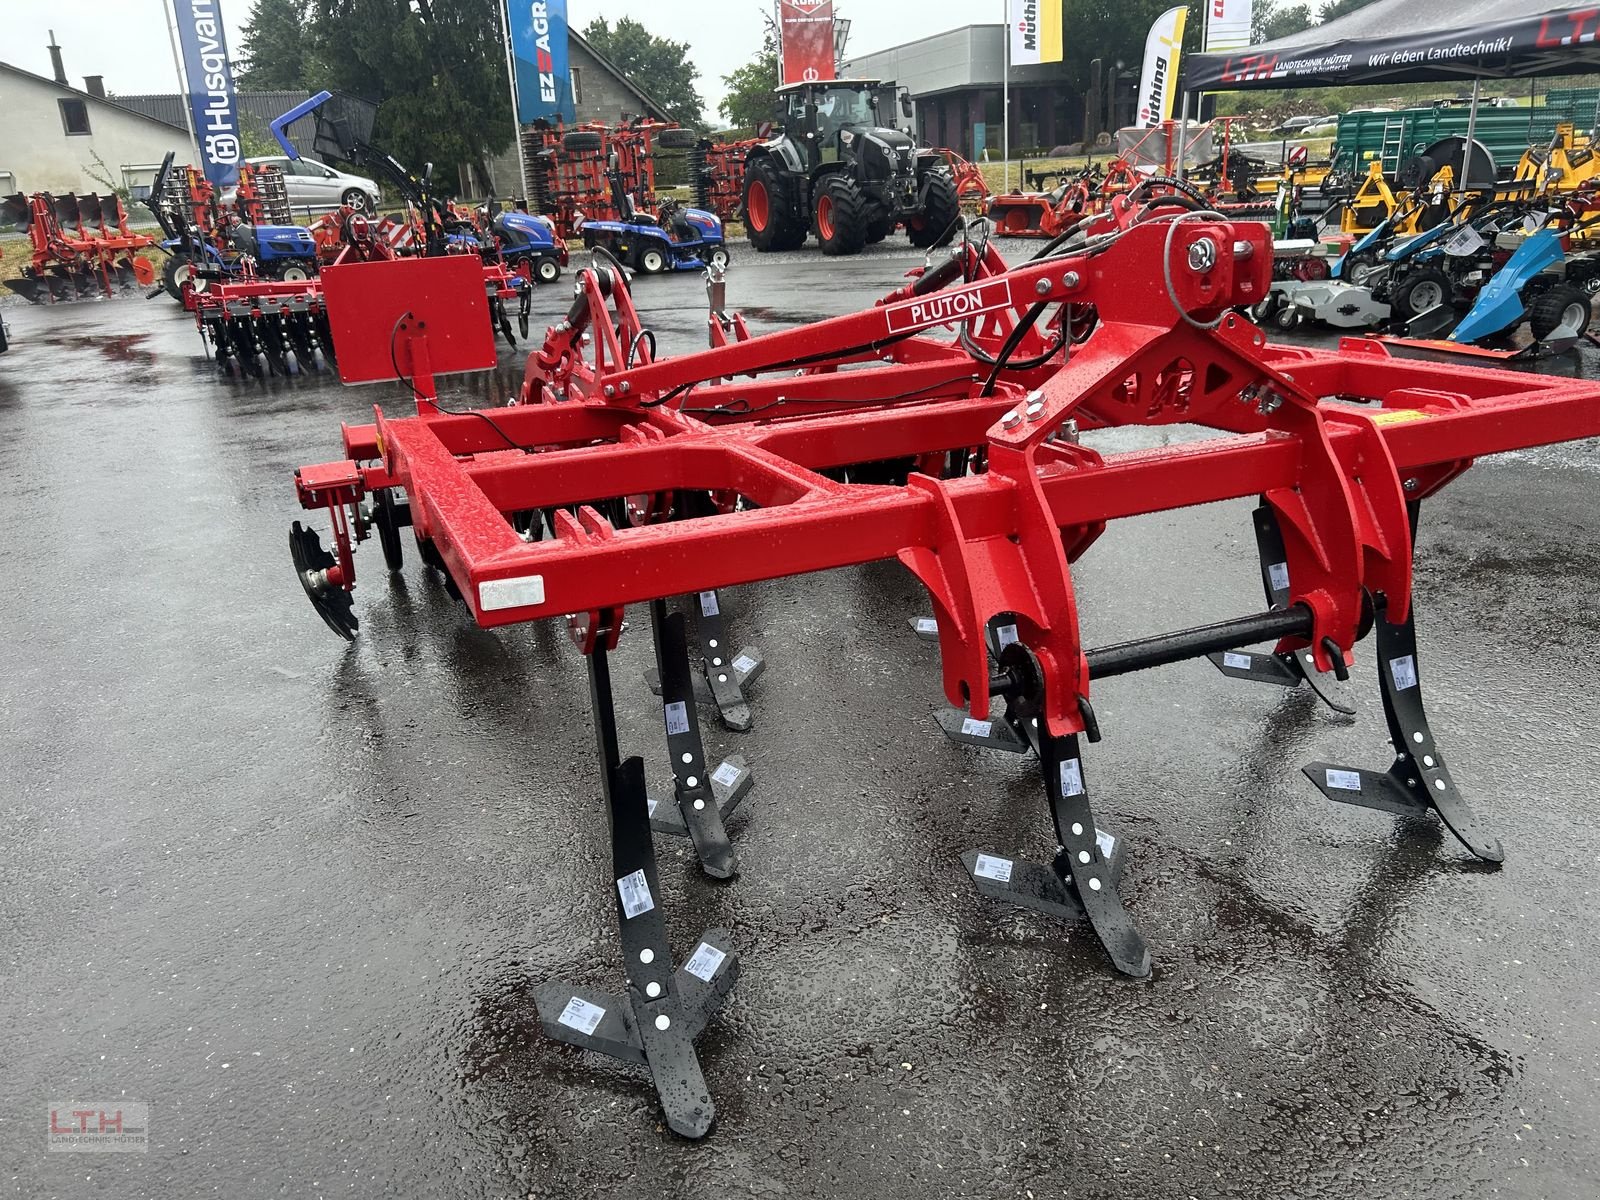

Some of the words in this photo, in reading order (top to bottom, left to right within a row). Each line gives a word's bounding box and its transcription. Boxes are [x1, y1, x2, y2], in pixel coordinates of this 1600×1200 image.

[1535, 9, 1600, 48] LT
[1275, 57, 1325, 71] LANDTECHNIK
[1324, 53, 1353, 65] HÜTTER
[1368, 53, 1389, 67] Wir
[1390, 50, 1424, 65] leben
[1427, 36, 1513, 60] Landtechnik!
[1220, 53, 1279, 82] LTH
[911, 290, 983, 323] PLUTON
